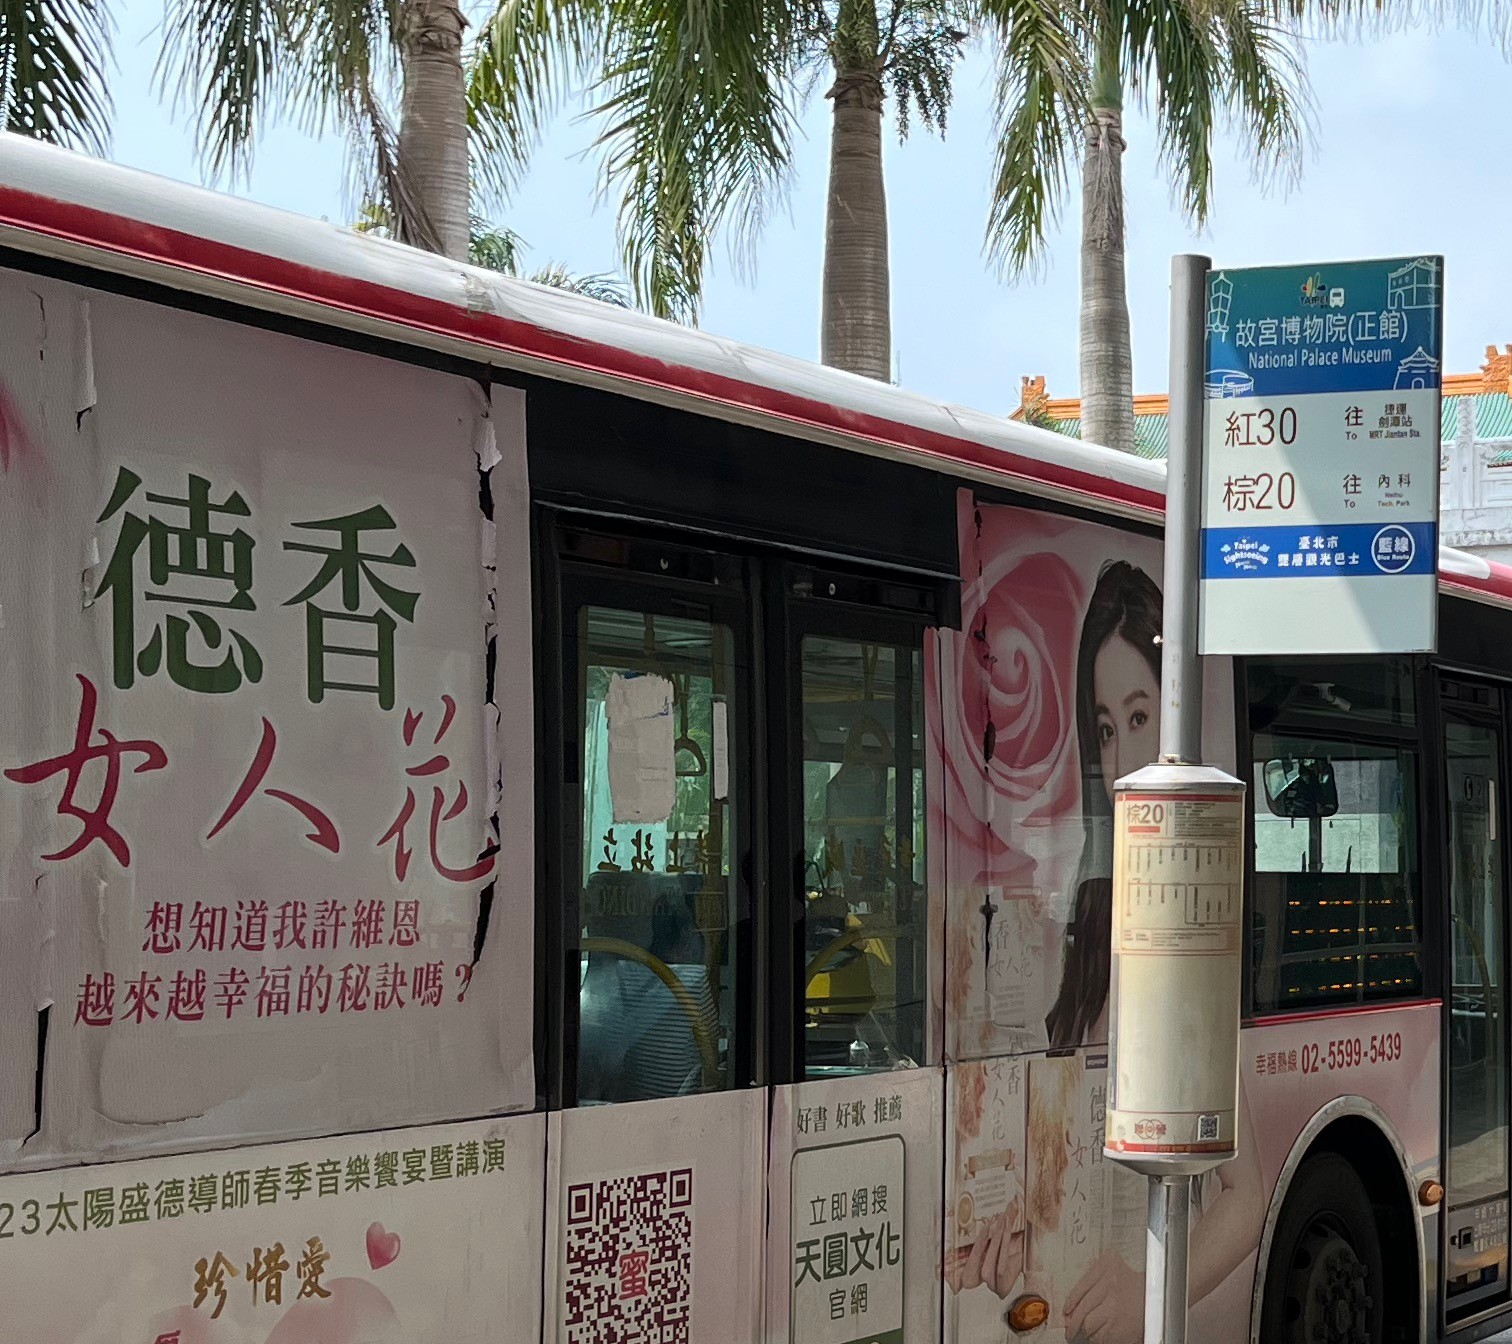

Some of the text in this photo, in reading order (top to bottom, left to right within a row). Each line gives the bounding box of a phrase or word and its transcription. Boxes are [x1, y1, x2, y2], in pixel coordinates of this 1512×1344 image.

[1235, 310, 1408, 349] 故宮博物院(正館)
[1249, 347, 1392, 369] National Palace Museum
[1224, 406, 1298, 448] 紅30
[1345, 406, 1363, 427] 往
[1345, 431, 1358, 441] To
[1222, 471, 1296, 513] 棕20
[1343, 474, 1361, 495] 往
[1344, 499, 1356, 508] To
[96, 465, 421, 711] 德香
[4, 674, 499, 882] 女人花
[142, 899, 421, 954] 想知道我許維恩
[1301, 1032, 1401, 1074] 02-5599-5439
[797, 1095, 902, 1134] 好書 好歌 推薦
[809, 1185, 887, 1226] 立即網搜
[795, 1221, 900, 1288] 天圓文化
[192, 1235, 333, 1320] 珍惜愛
[618, 1251, 649, 1301] 蜜
[829, 1283, 868, 1320] 官網
